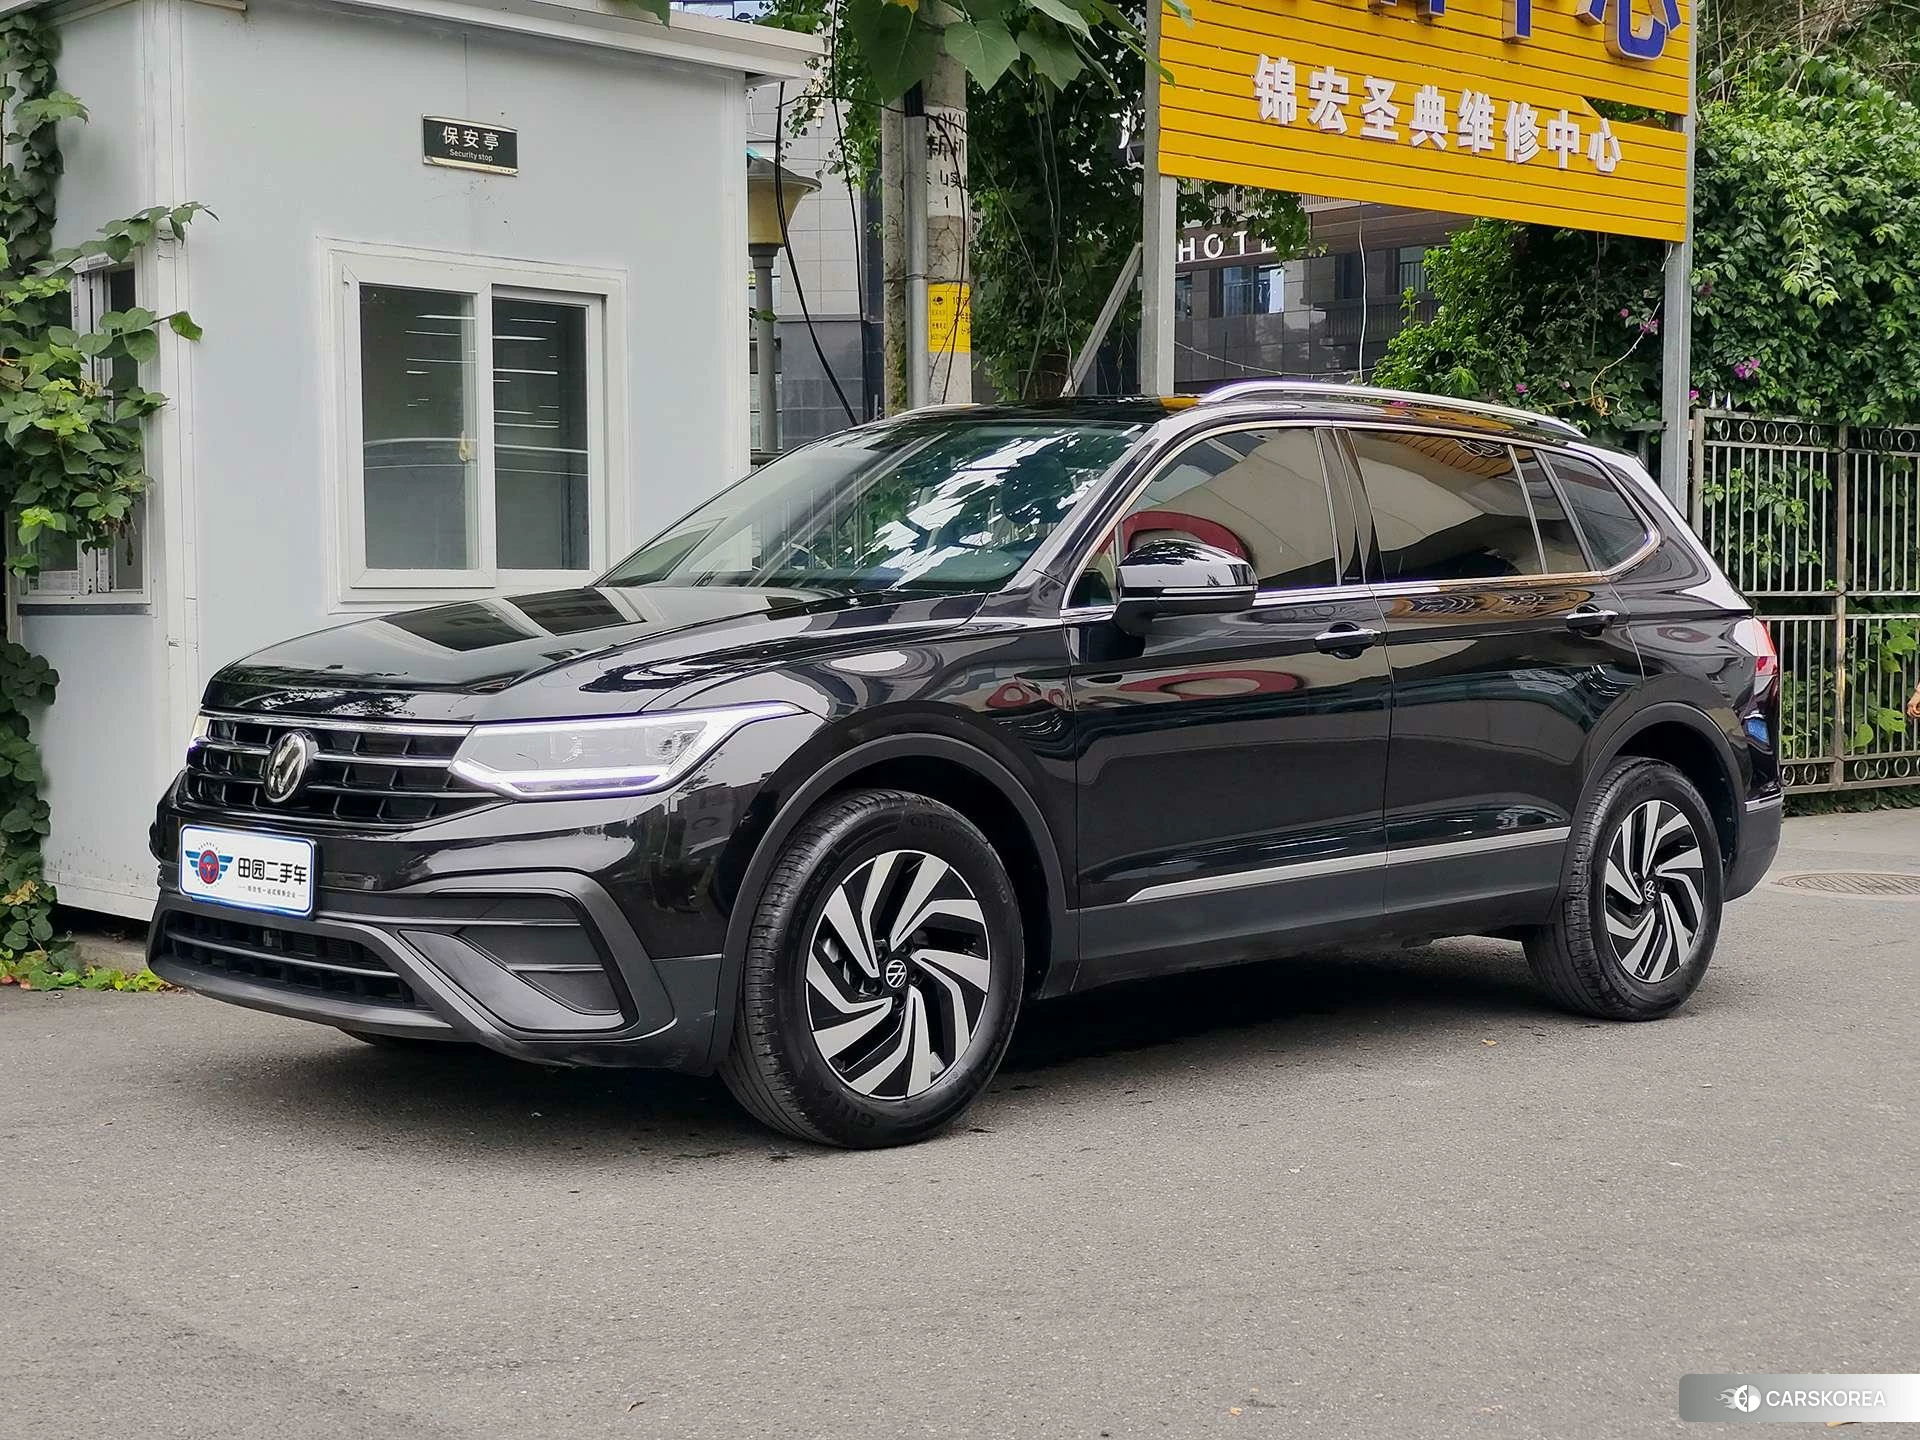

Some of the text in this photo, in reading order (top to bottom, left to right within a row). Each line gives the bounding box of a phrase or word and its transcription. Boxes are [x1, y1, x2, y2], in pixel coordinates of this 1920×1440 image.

[1254, 53, 1623, 173] 锦宏圣典维修中心
[442, 125, 499, 151] 保安亭
[449, 148, 493, 162] Security stop
[237, 857, 307, 885] 田园二手车
